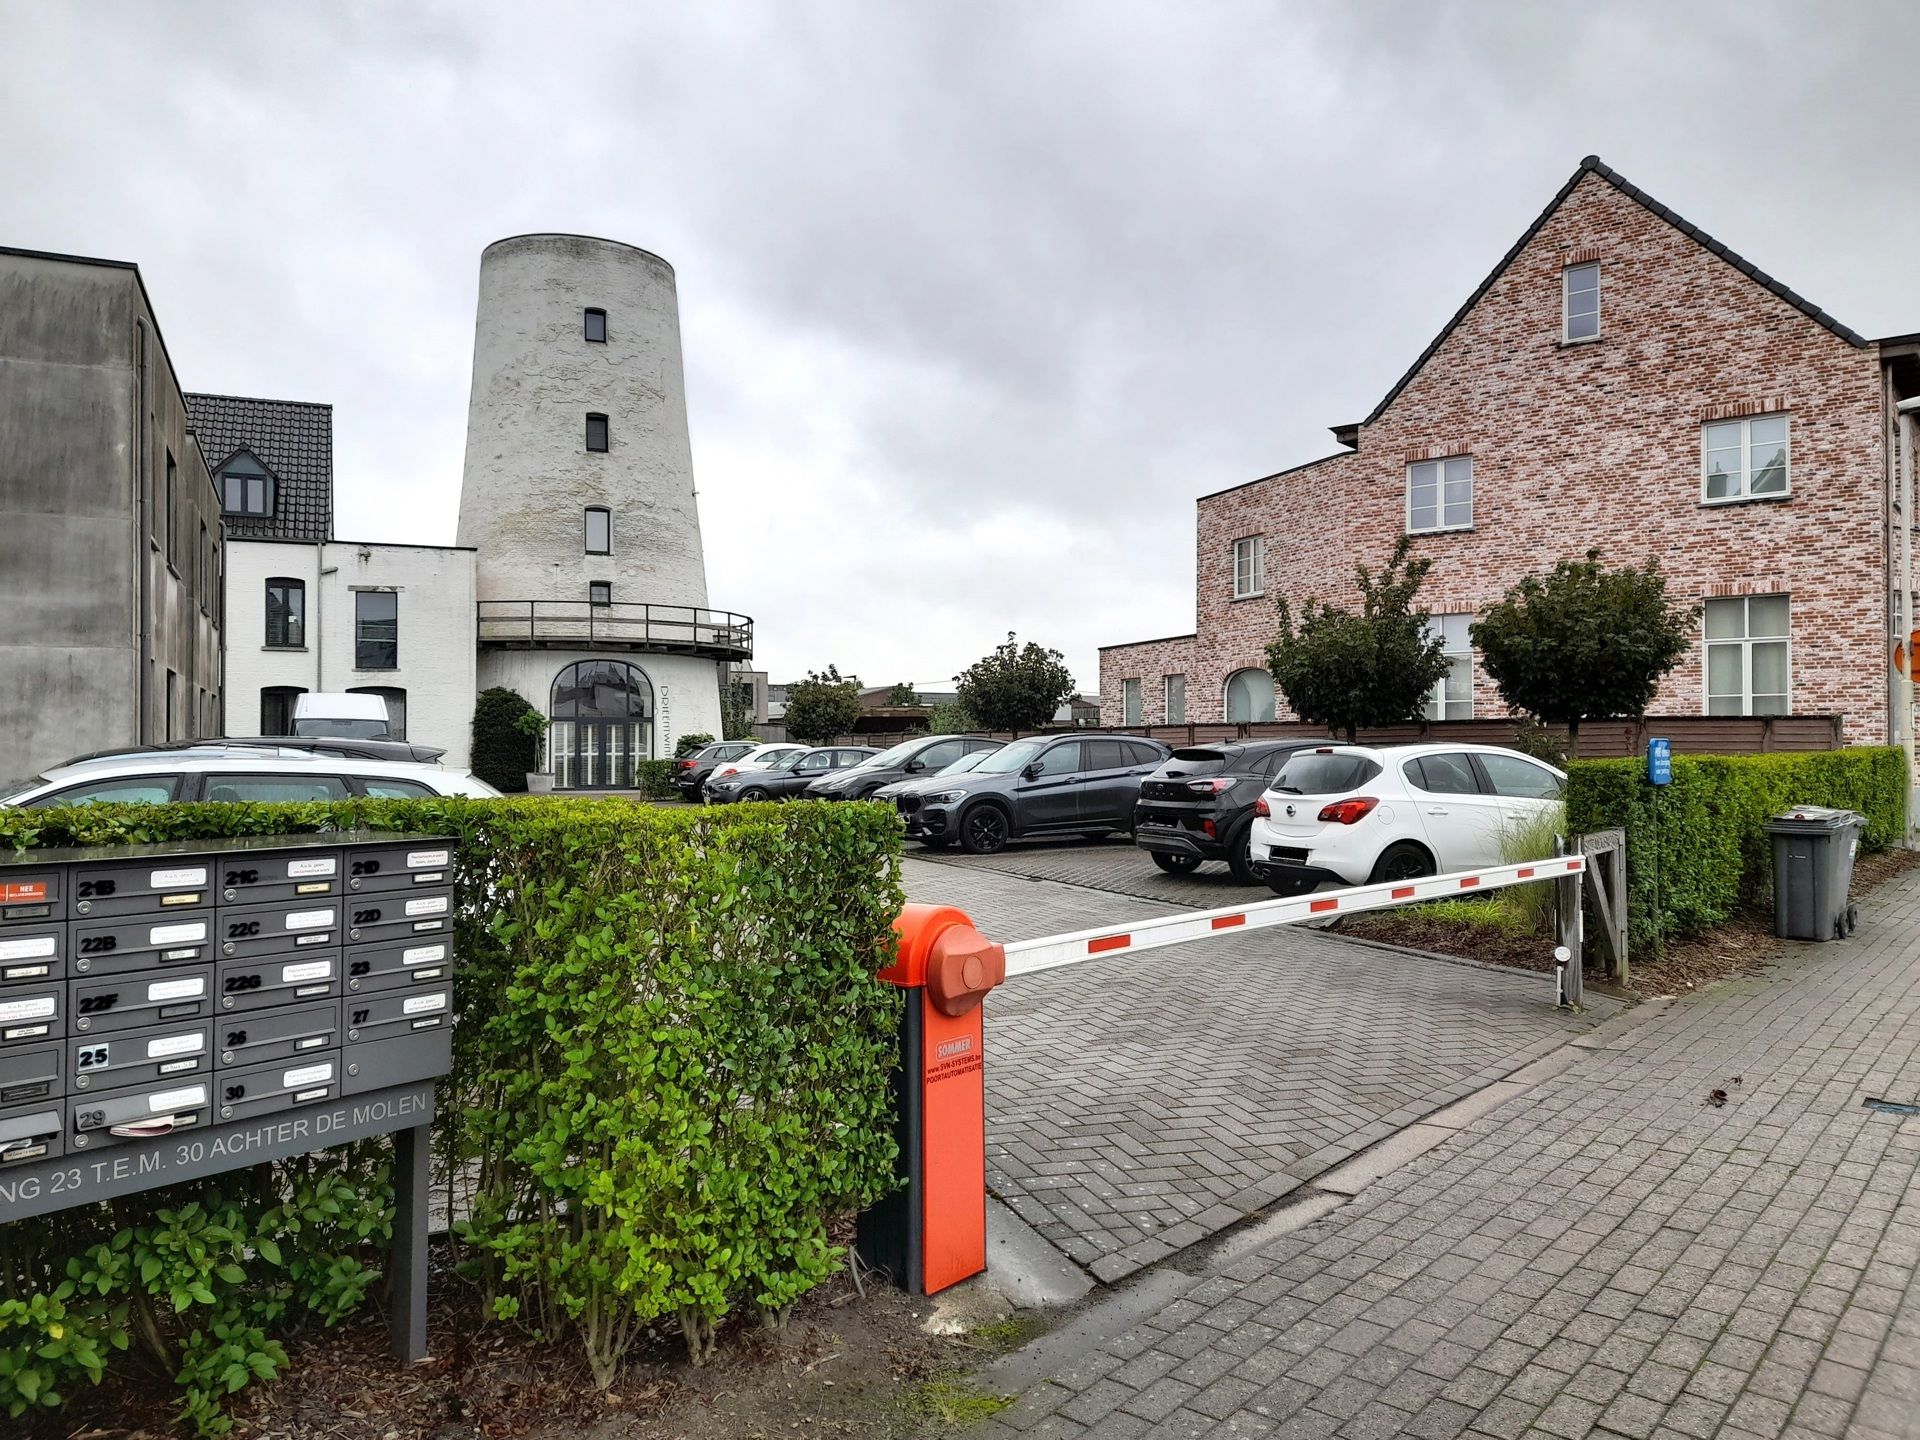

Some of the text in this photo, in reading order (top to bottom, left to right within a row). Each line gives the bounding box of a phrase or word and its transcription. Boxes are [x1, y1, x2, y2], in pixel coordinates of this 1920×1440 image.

[352, 860, 380, 875] 21D
[226, 869, 258, 886] 21C
[79, 880, 115, 897] 21B
[354, 909, 381, 924] 22D
[229, 922, 260, 938] 22C
[81, 936, 117, 953] 22B
[351, 961, 371, 976] 23
[225, 975, 261, 992] 22G
[80, 994, 118, 1014] 22F
[352, 1009, 369, 1024] 27
[227, 1030, 247, 1046] 26
[938, 1040, 971, 1057] SOMMER
[79, 1048, 107, 1067] 25
[926, 1063, 982, 1084] POORTAUTOMATISATIE
[225, 1085, 245, 1100] 30
[80, 1109, 106, 1129] 29
[50, 1167, 82, 1195] 23
[91, 1152, 166, 1183] T.E.M.
[175, 1141, 204, 1167] 30
[209, 1118, 308, 1160] ACHTER
[316, 1110, 346, 1135] DE
[352, 1092, 426, 1127] MOLEN
